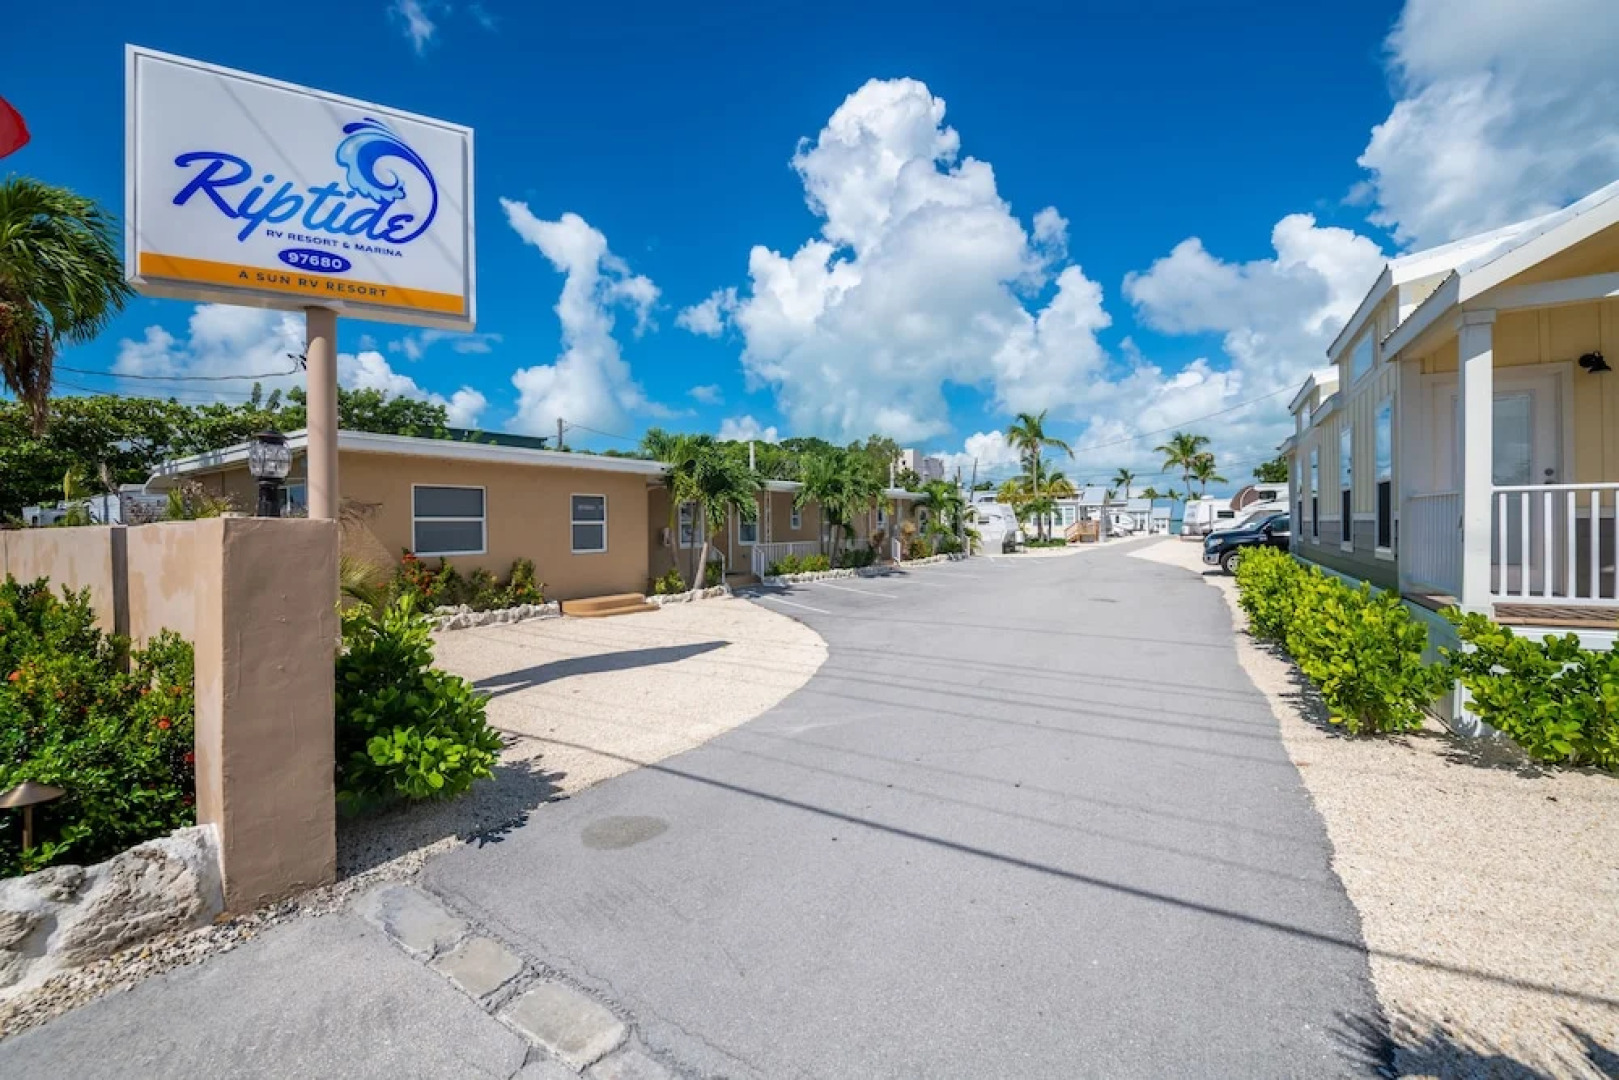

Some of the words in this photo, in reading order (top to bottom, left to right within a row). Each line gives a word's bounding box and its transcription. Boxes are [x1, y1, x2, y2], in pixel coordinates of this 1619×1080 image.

[172, 151, 430, 243] Riptide
[266, 229, 283, 239] RV
[287, 232, 339, 247] RESORT
[342, 241, 351, 249] &
[354, 243, 403, 257] MARINA
[287, 252, 343, 269] 97680
[238, 270, 249, 280] A
[255, 272, 291, 285] SUN
[298, 277, 319, 288] RV
[326, 282, 387, 297] RESORT
